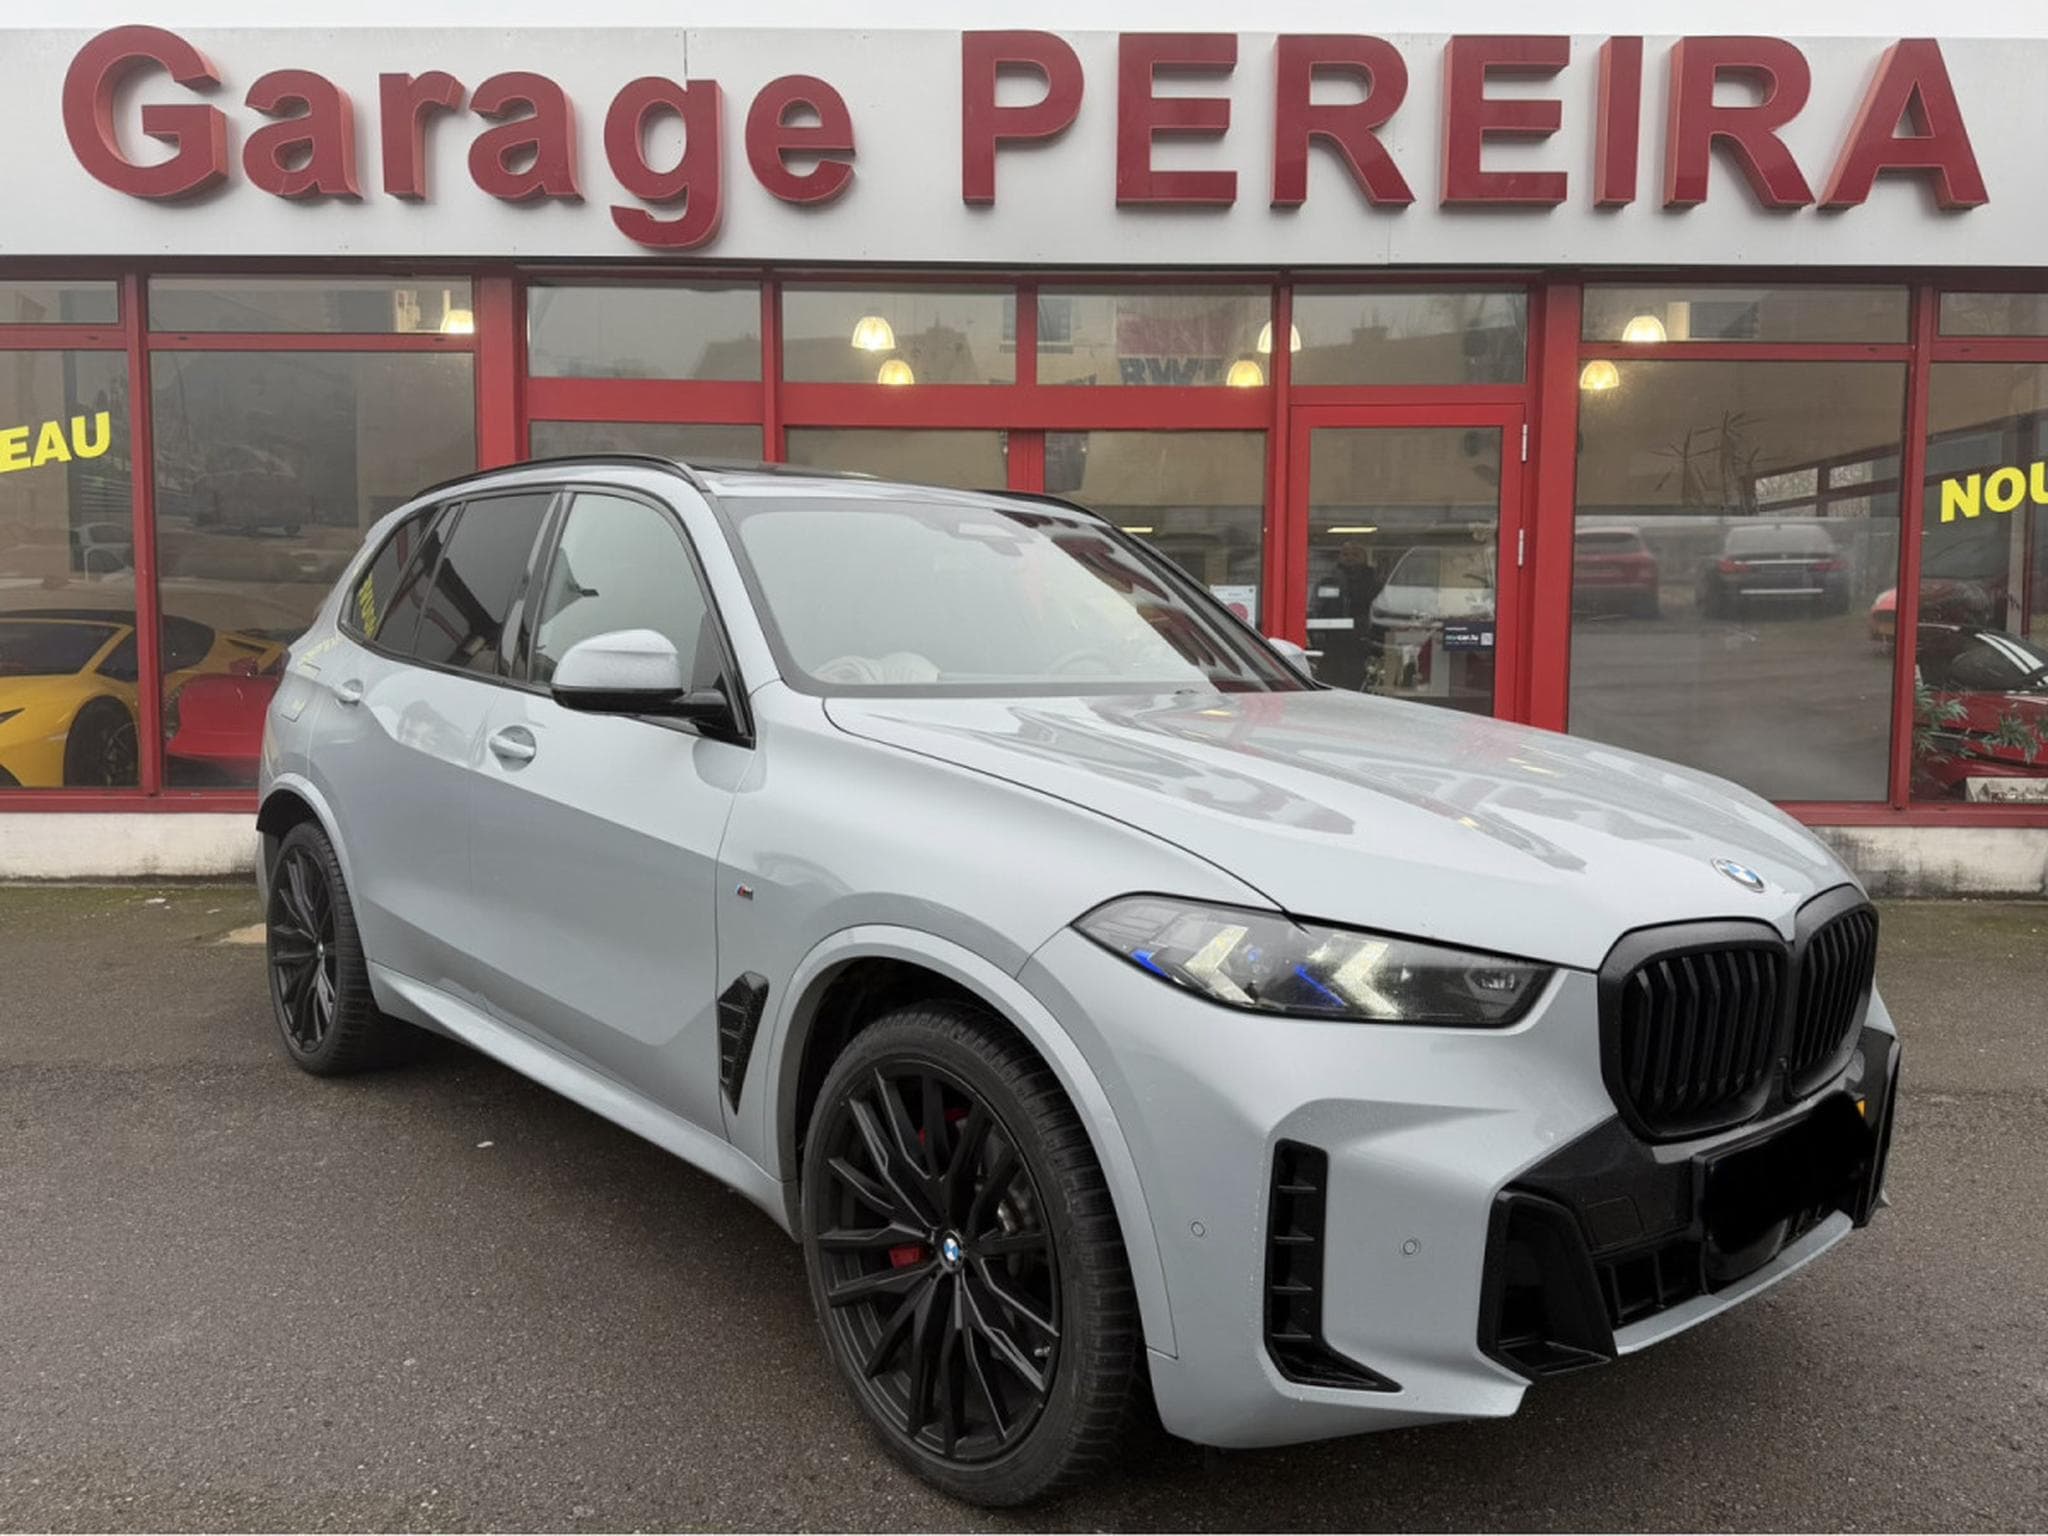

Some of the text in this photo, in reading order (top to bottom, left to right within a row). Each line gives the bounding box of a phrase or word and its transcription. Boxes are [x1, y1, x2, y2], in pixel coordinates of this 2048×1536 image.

[62, 25, 1990, 249] Garage PEREIRA
[0, 411, 110, 473] EAU
